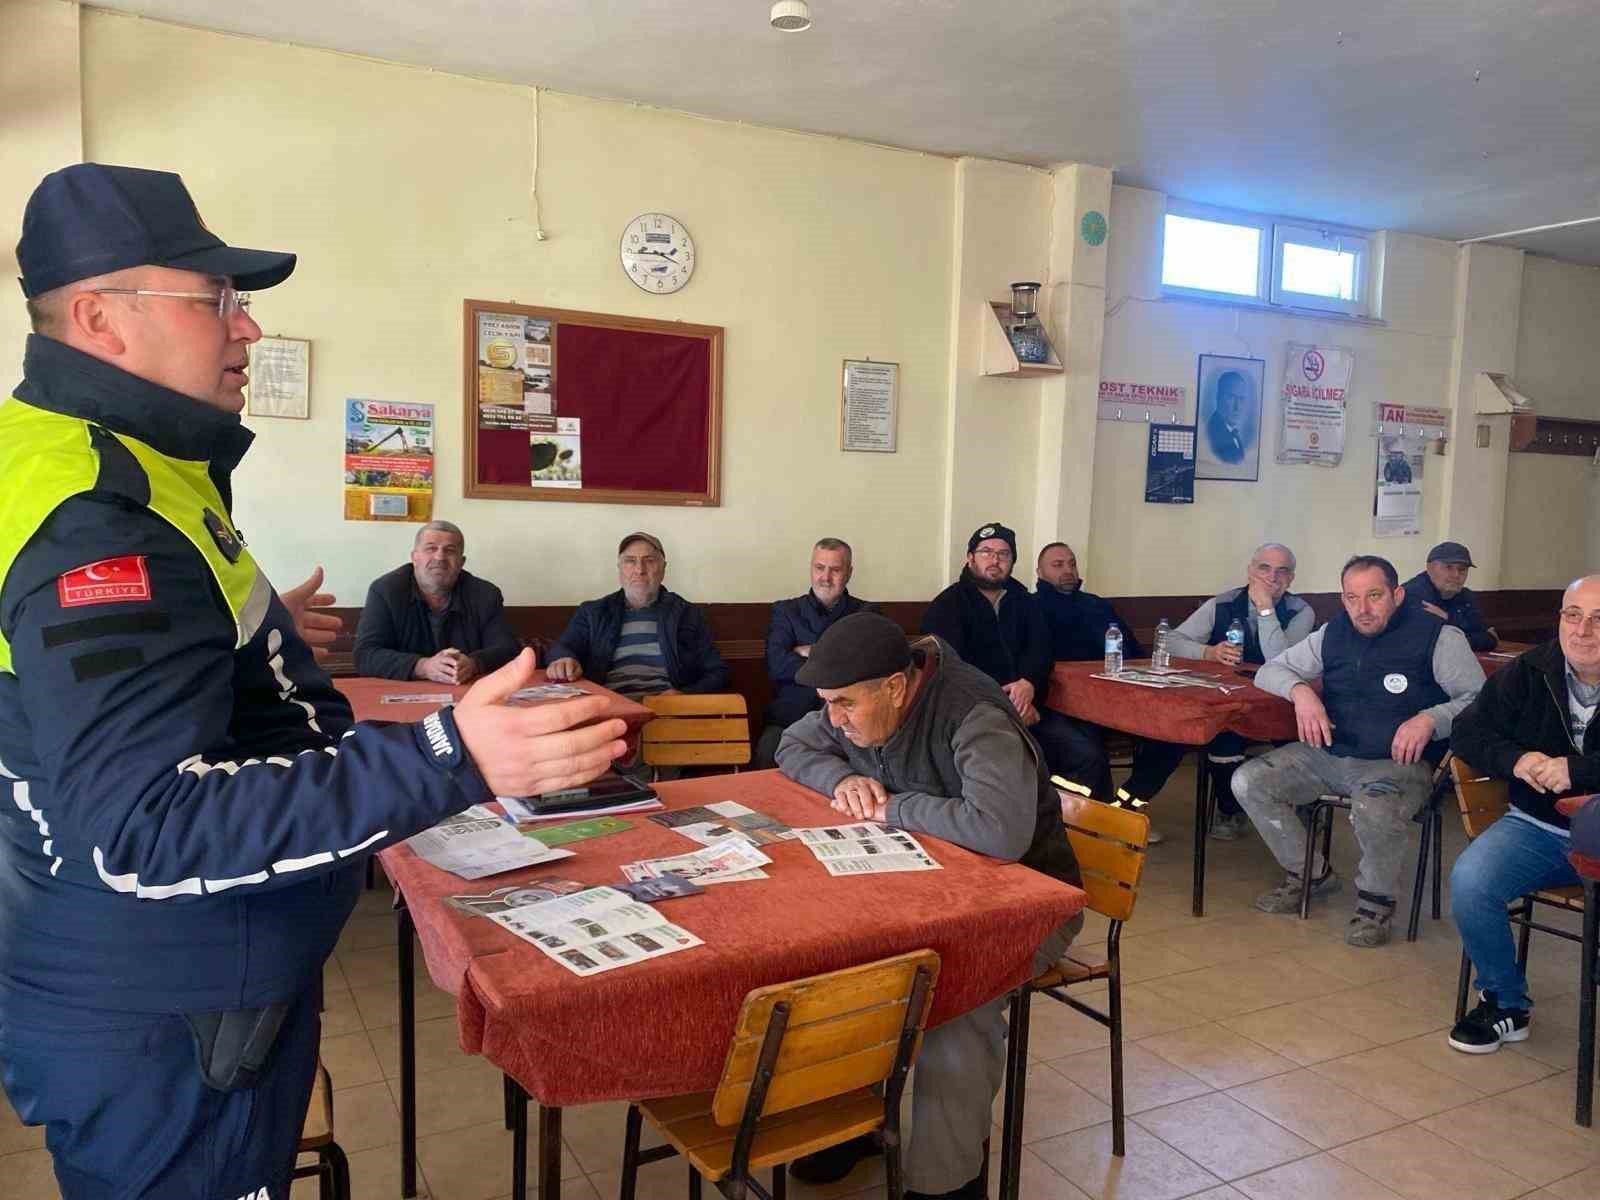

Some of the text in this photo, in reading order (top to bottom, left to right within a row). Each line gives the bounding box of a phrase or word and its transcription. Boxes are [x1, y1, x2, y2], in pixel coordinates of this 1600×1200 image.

[681, 238, 687, 247] 2
[632, 264, 638, 273] 8
[657, 279, 664, 289] 6
[367, 403, 432, 418] Sakarya
[1379, 403, 1405, 423] TAN
